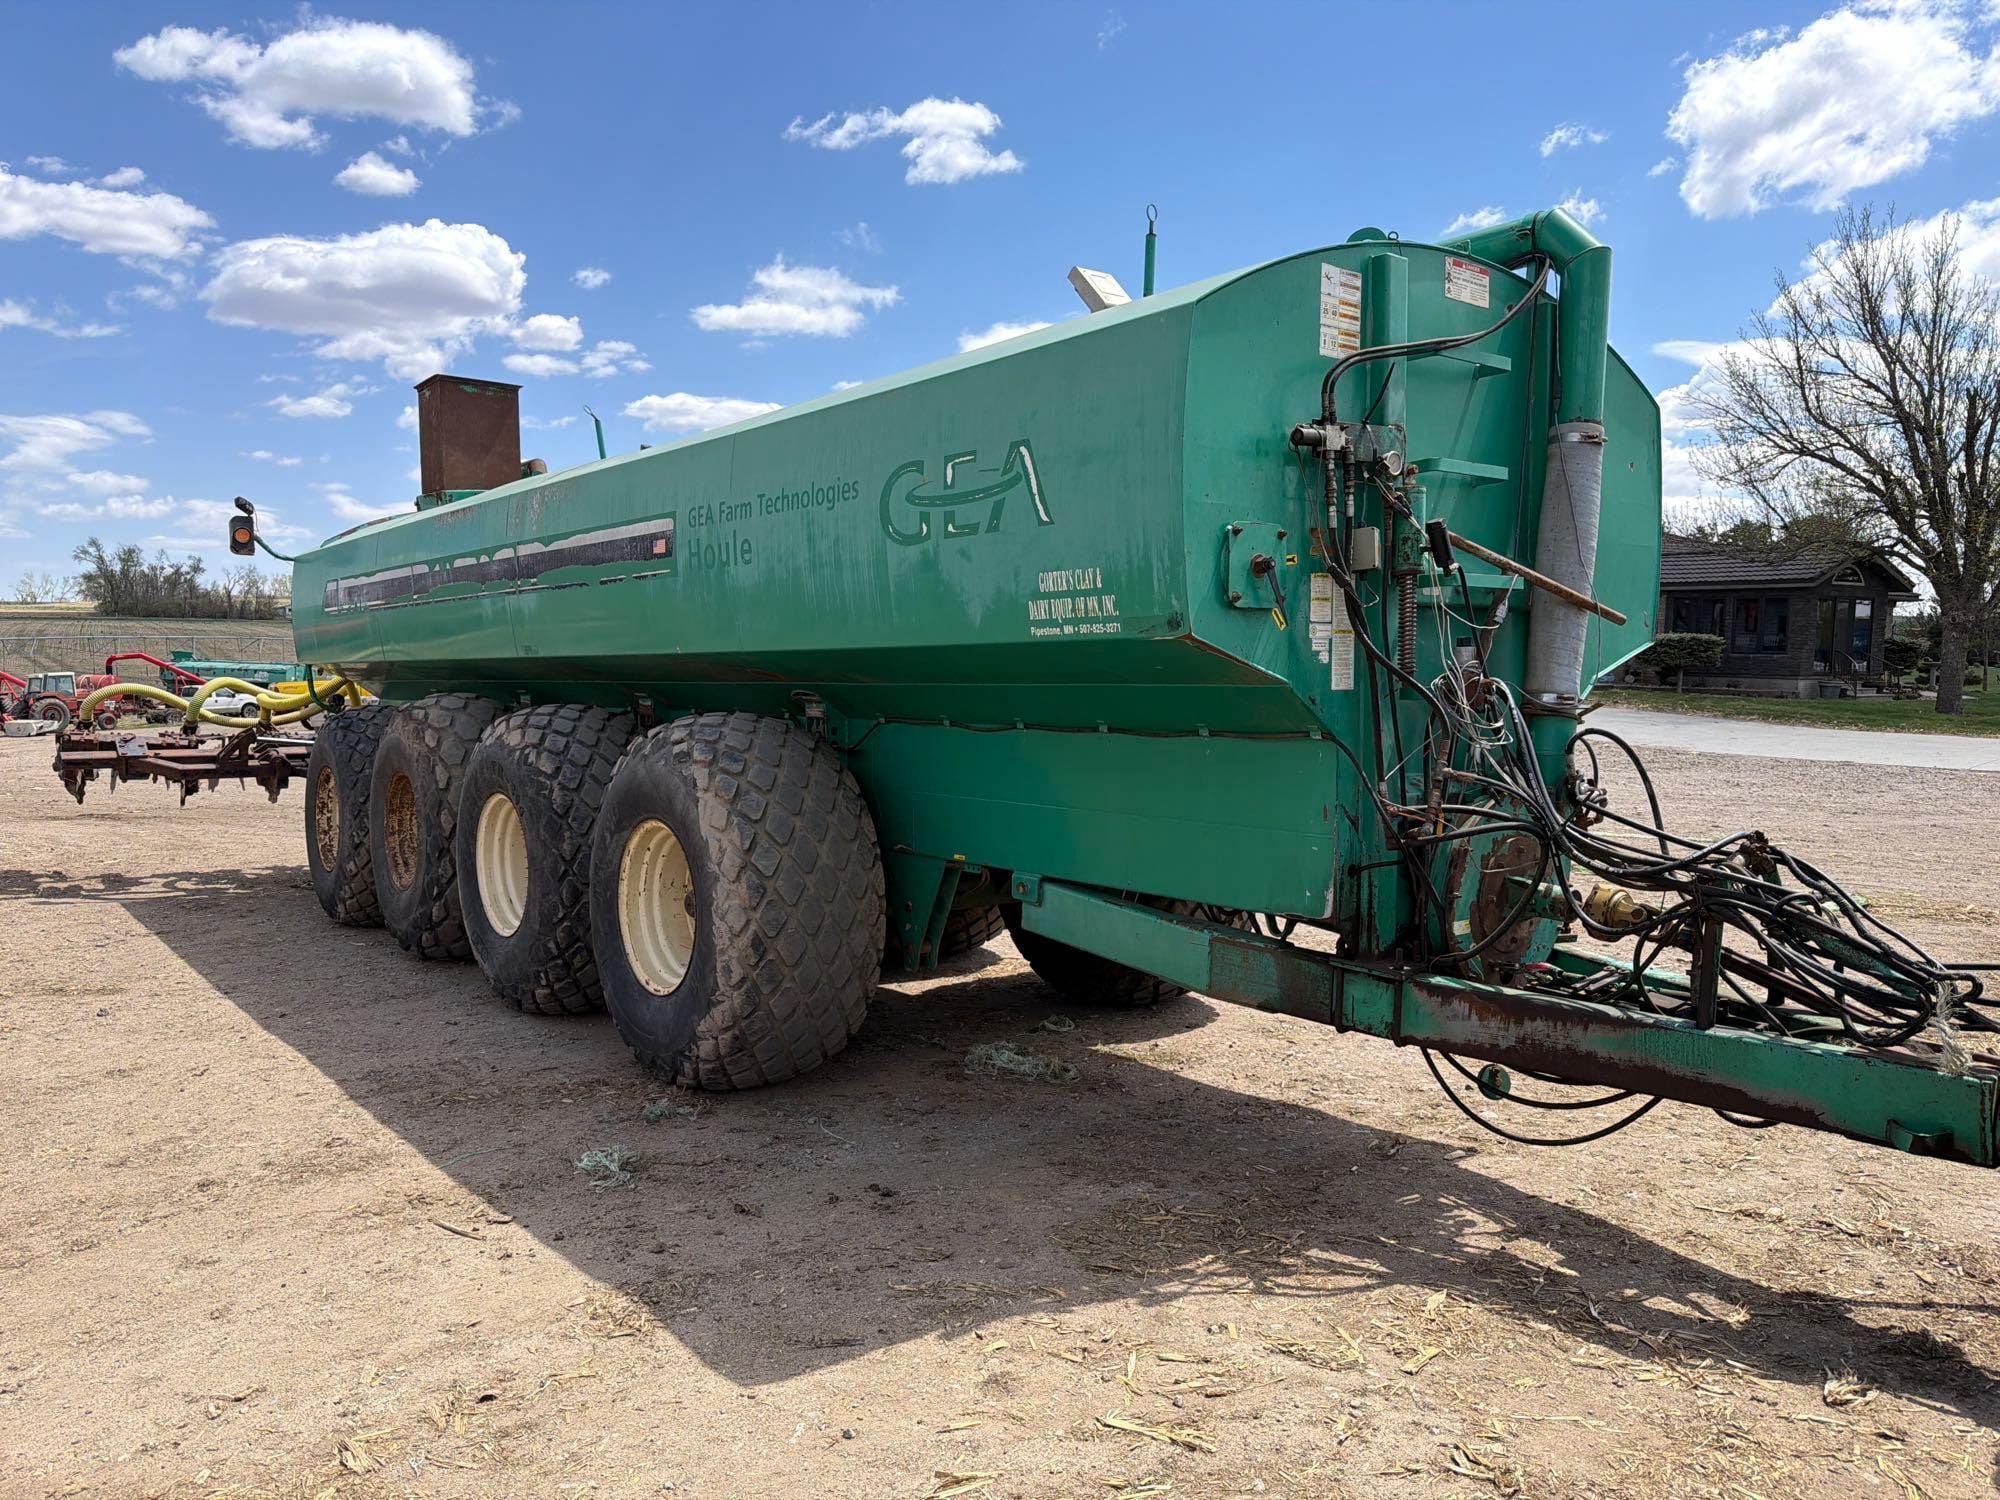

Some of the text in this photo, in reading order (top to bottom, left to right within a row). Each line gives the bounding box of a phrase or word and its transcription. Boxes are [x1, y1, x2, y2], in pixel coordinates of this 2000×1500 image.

[688, 476, 859, 528] GEA Farm Technologies
[880, 438, 1055, 546] GEA
[688, 529, 753, 570] Houle
[1039, 567, 1102, 592] GORTER'S CLAY &
[1029, 595, 1119, 623] DAIRY EQUIP. OF MN, INC.
[1031, 626, 1063, 638] Pipestone,
[1063, 625, 1074, 634] MN
